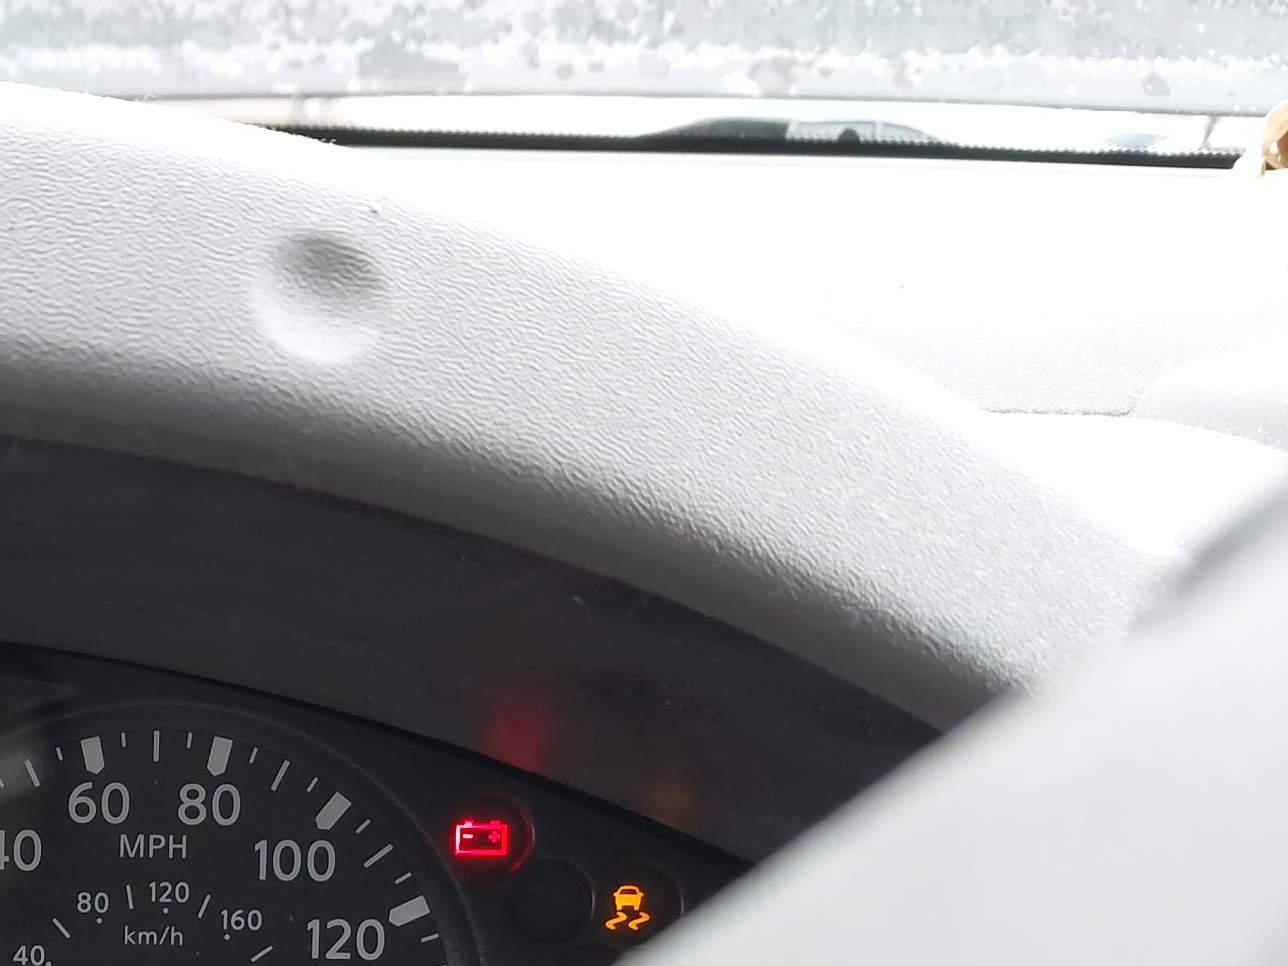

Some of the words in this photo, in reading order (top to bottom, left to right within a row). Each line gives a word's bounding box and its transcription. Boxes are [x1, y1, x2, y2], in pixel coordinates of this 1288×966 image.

[68, 782, 130, 825] 60
[177, 784, 241, 827] 80
[119, 834, 187, 859] MPH
[254, 839, 336, 882] 100
[77, 892, 109, 914] 80
[149, 882, 190, 903] 120
[222, 909, 263, 931] 160
[123, 925, 184, 946] km/h
[307, 918, 386, 961] 120
[13, 945, 46, 966] 40
